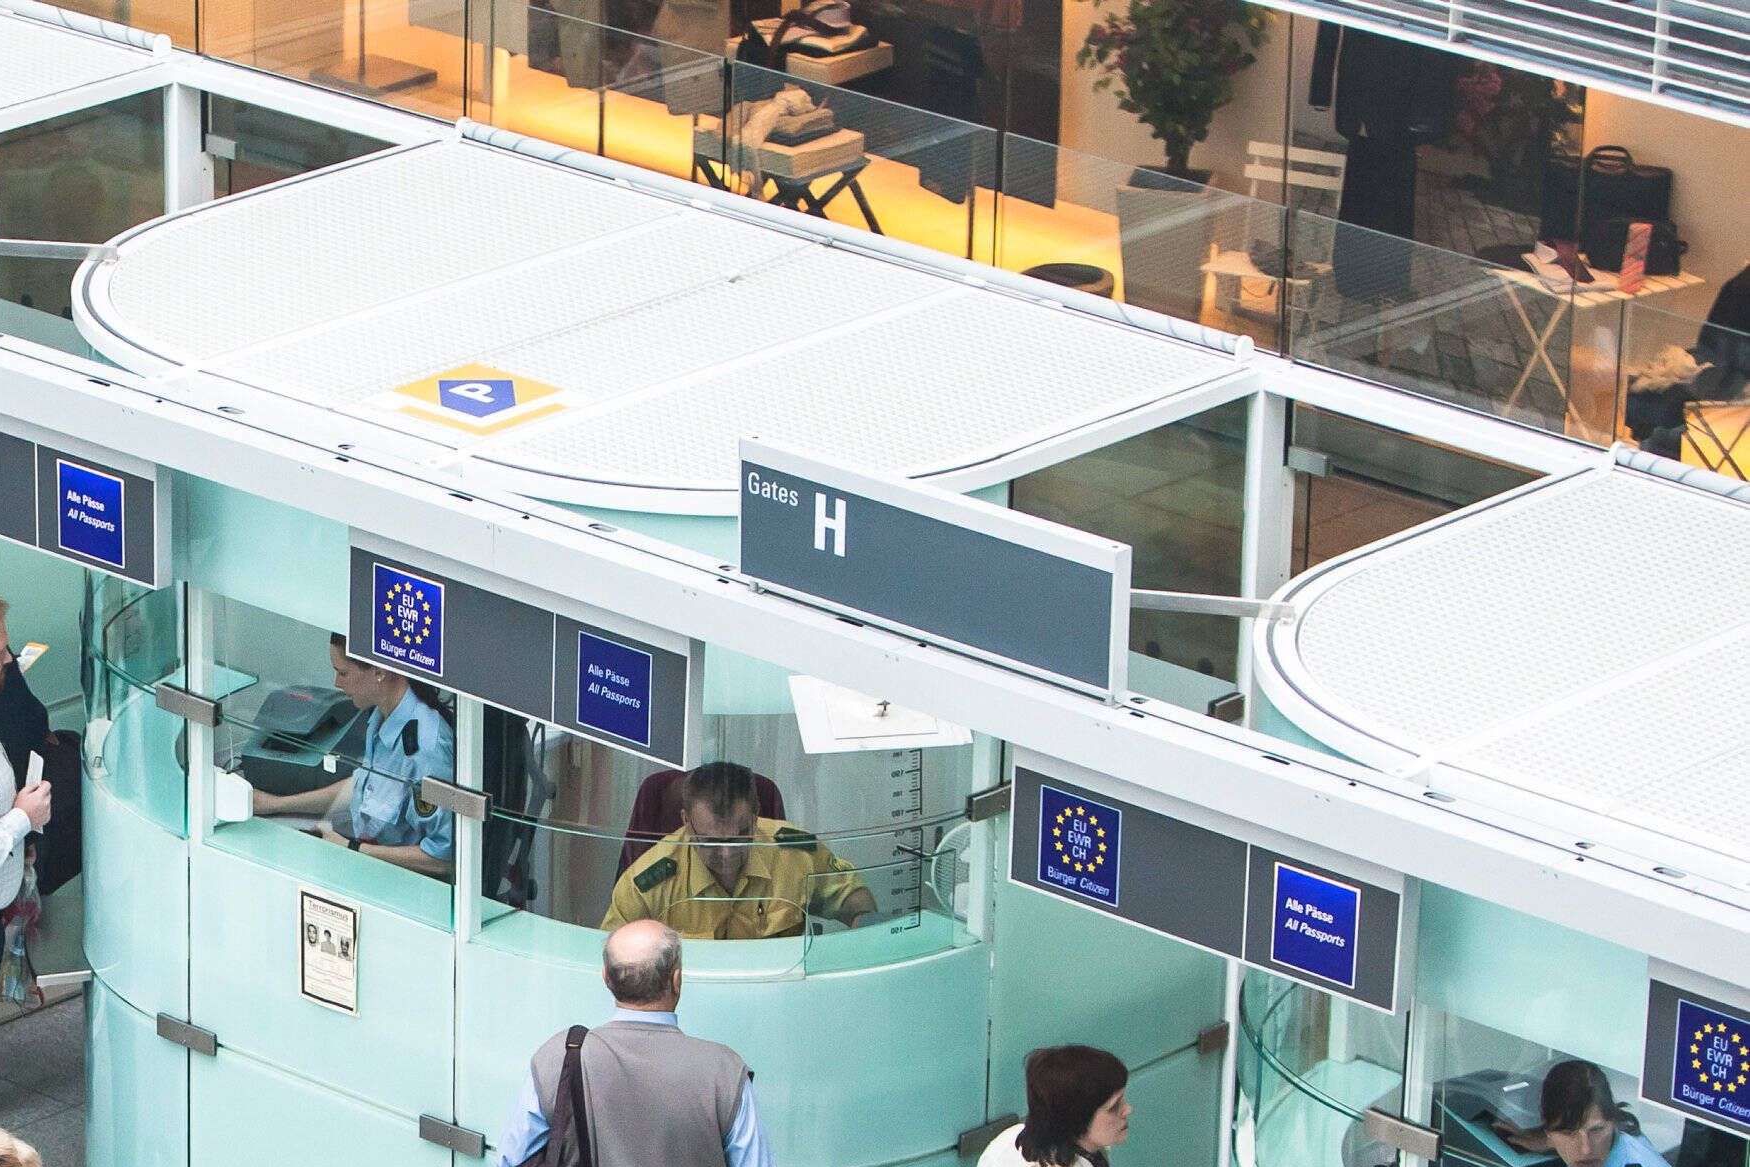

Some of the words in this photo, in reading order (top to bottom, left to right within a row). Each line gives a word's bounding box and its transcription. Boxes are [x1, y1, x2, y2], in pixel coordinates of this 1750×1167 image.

[66, 490, 81, 504] Alle
[82, 494, 105, 512] Pässe
[67, 508, 78, 520] All
[78, 511, 115, 532] Passports
[748, 471, 799, 507] Gates
[814, 491, 847, 558] H
[402, 594, 414, 608] EU
[397, 605, 419, 622] EWR
[401, 619, 414, 633] CH
[380, 639, 406, 658] Bürger
[409, 649, 435, 667] Citizen
[588, 663, 604, 678] Alle
[605, 669, 630, 687] Pässe
[587, 682, 600, 695] All
[600, 686, 641, 709] Passports
[1073, 819, 1087, 834] EU
[1067, 830, 1092, 849] EWR
[1072, 845, 1086, 860] CH
[1047, 865, 1077, 885] Bürger
[1080, 877, 1110, 897] Citizen
[1285, 897, 1304, 914] Alle
[1305, 903, 1334, 924] Pässe
[1284, 917, 1299, 931] All
[1299, 922, 1346, 948] Passports
[1713, 1035, 1728, 1051] EU
[1706, 1048, 1733, 1068] EWR
[1711, 1064, 1727, 1080] CH
[1682, 1084, 1715, 1105] Bürger
[1718, 1097, 1750, 1118] Citizen
